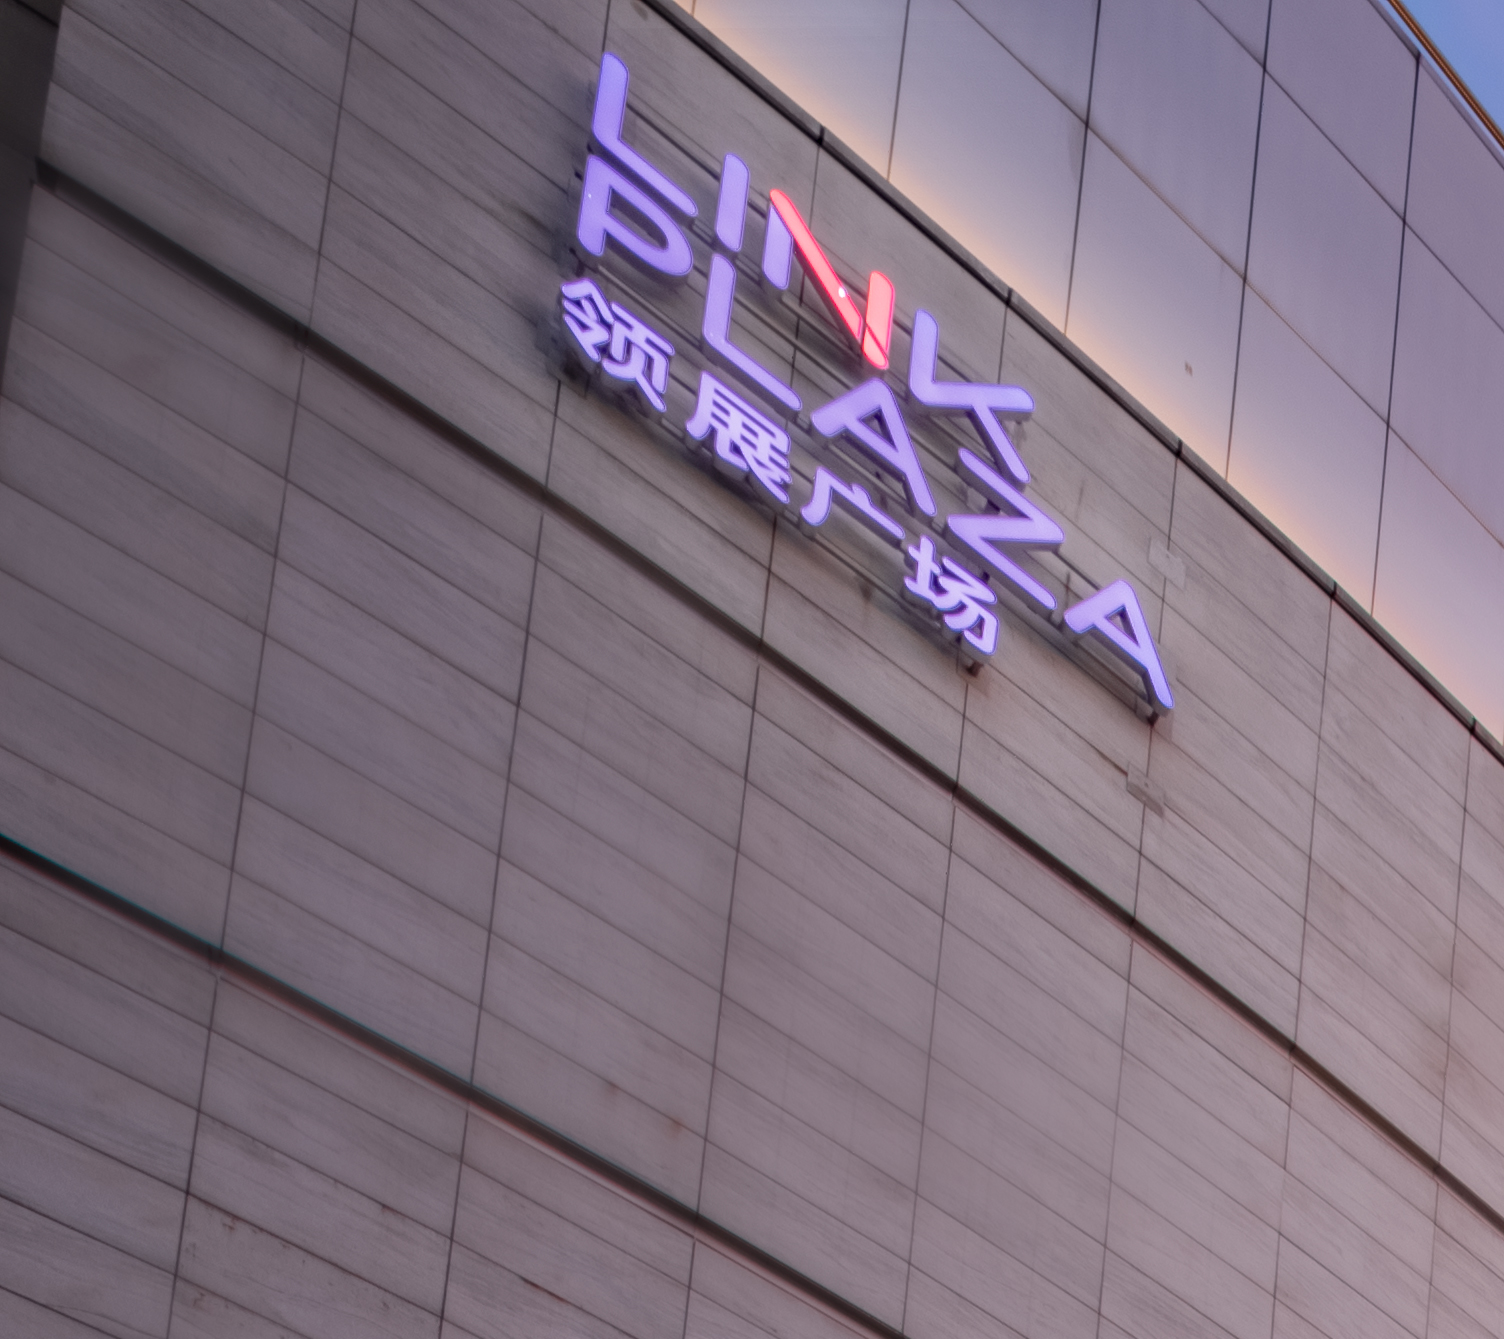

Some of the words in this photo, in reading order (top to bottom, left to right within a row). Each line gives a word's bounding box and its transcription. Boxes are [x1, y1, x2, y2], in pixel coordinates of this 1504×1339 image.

[560, 276, 1000, 656] 领展广场
[577, 152, 1175, 710] PLAZA
[592, 52, 1035, 487] LINK
